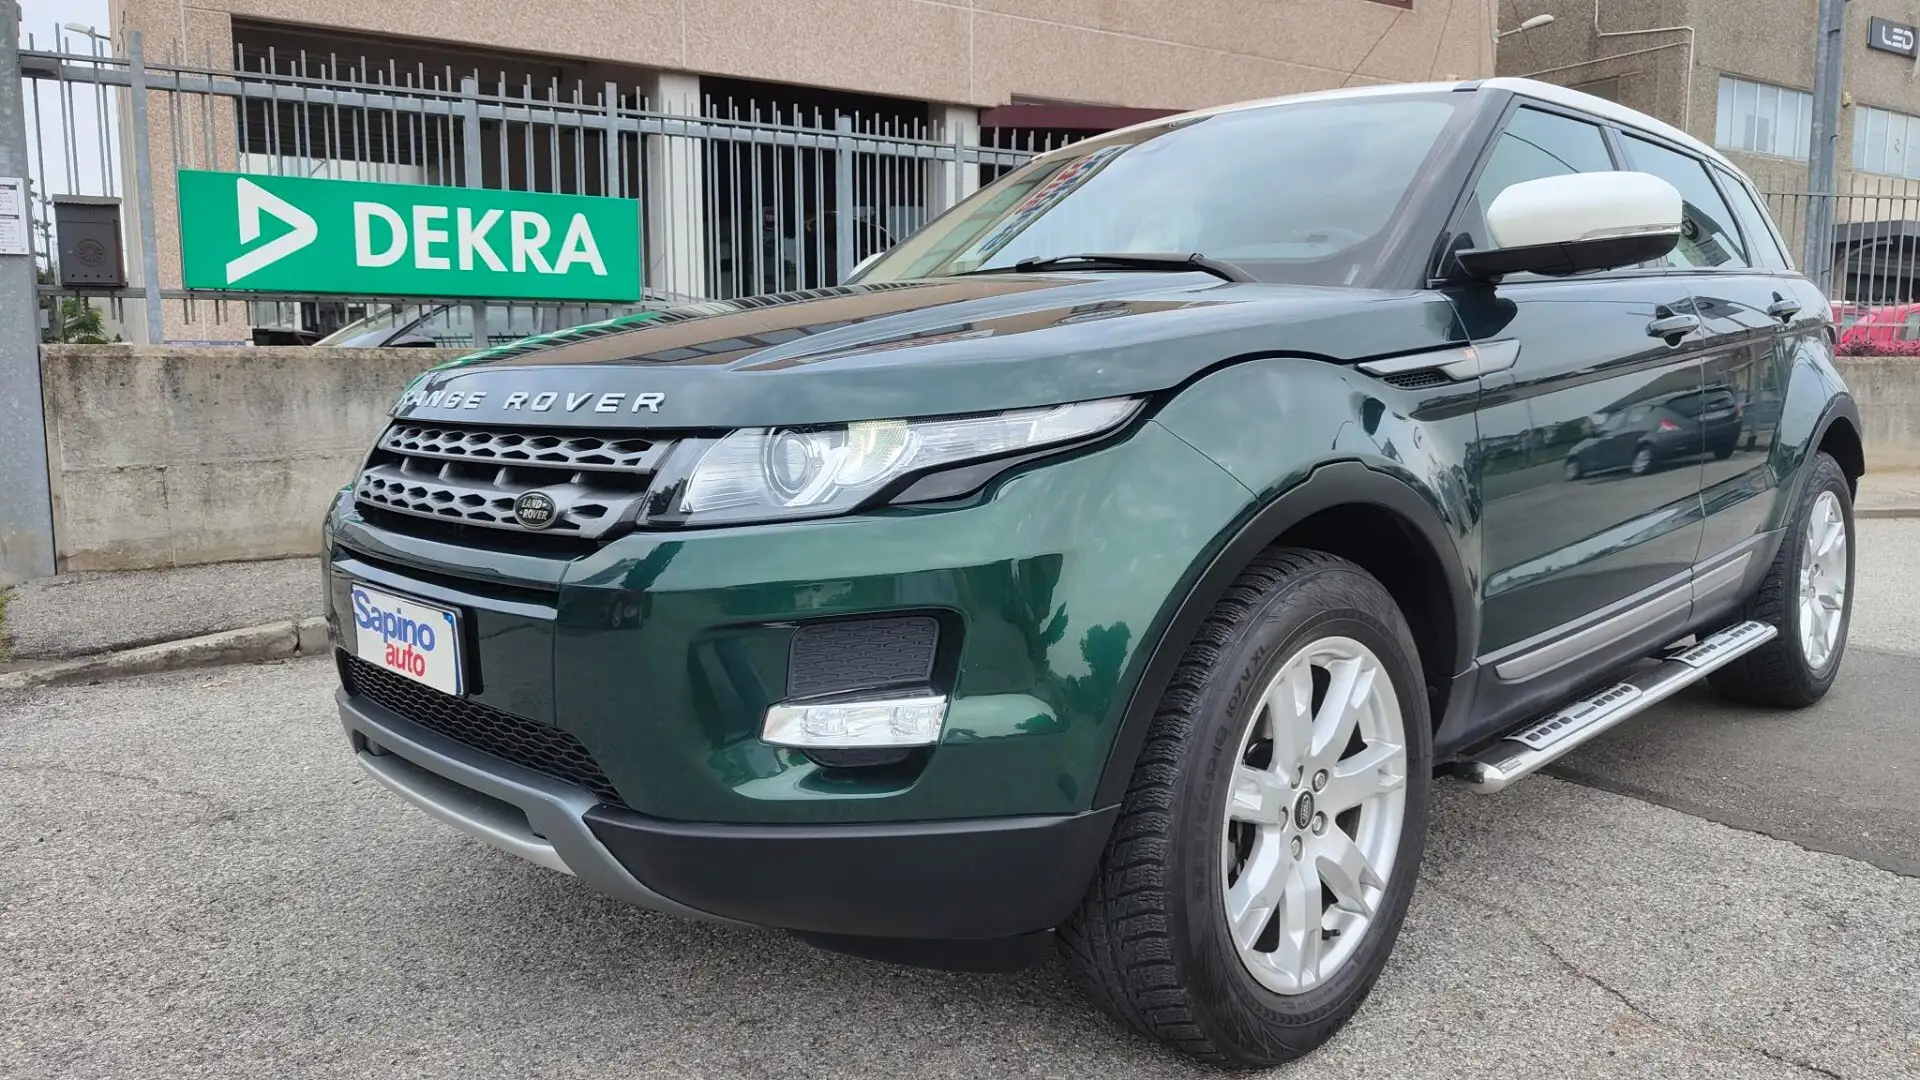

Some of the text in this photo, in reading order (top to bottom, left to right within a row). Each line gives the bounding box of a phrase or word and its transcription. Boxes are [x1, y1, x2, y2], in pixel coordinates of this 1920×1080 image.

[1882, 25, 1914, 50] LED
[353, 201, 608, 276] DEKRA
[400, 390, 666, 413] RANGE ROVER
[522, 508, 549, 520] ROVER
[353, 589, 435, 651] Sapino
[385, 643, 425, 677] auto
